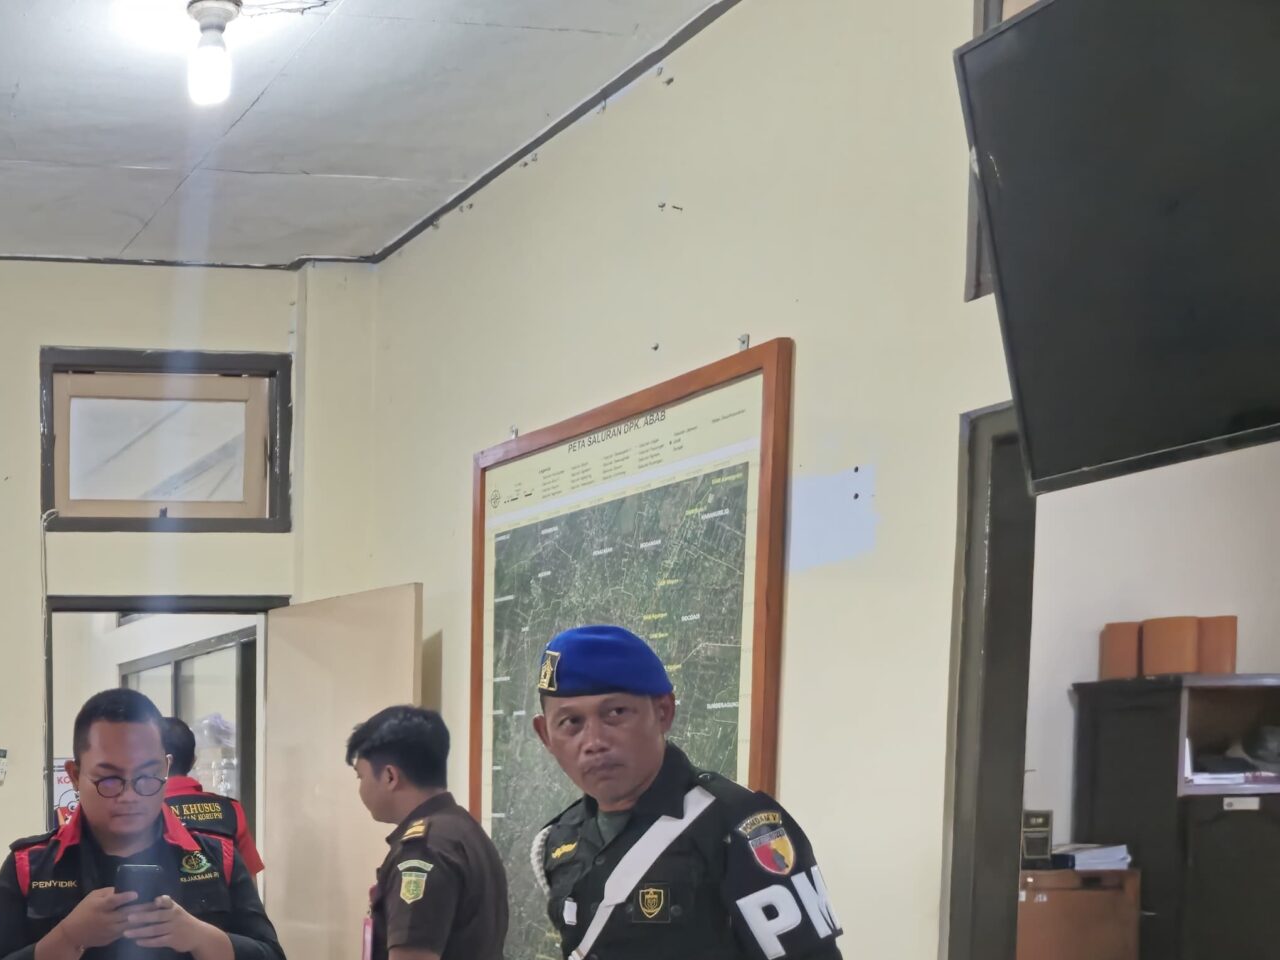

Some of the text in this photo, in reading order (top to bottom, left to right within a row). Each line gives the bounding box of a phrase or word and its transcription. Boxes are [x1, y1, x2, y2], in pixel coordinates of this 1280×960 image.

[567, 440, 586, 454] PETA
[587, 427, 622, 447] SALURAN
[643, 410, 666, 427] ABAB
[182, 803, 221, 815] KHUSUS
[198, 812, 223, 820] KORUPSI
[31, 880, 78, 889] PENYIDIK
[736, 865, 843, 960] PM
